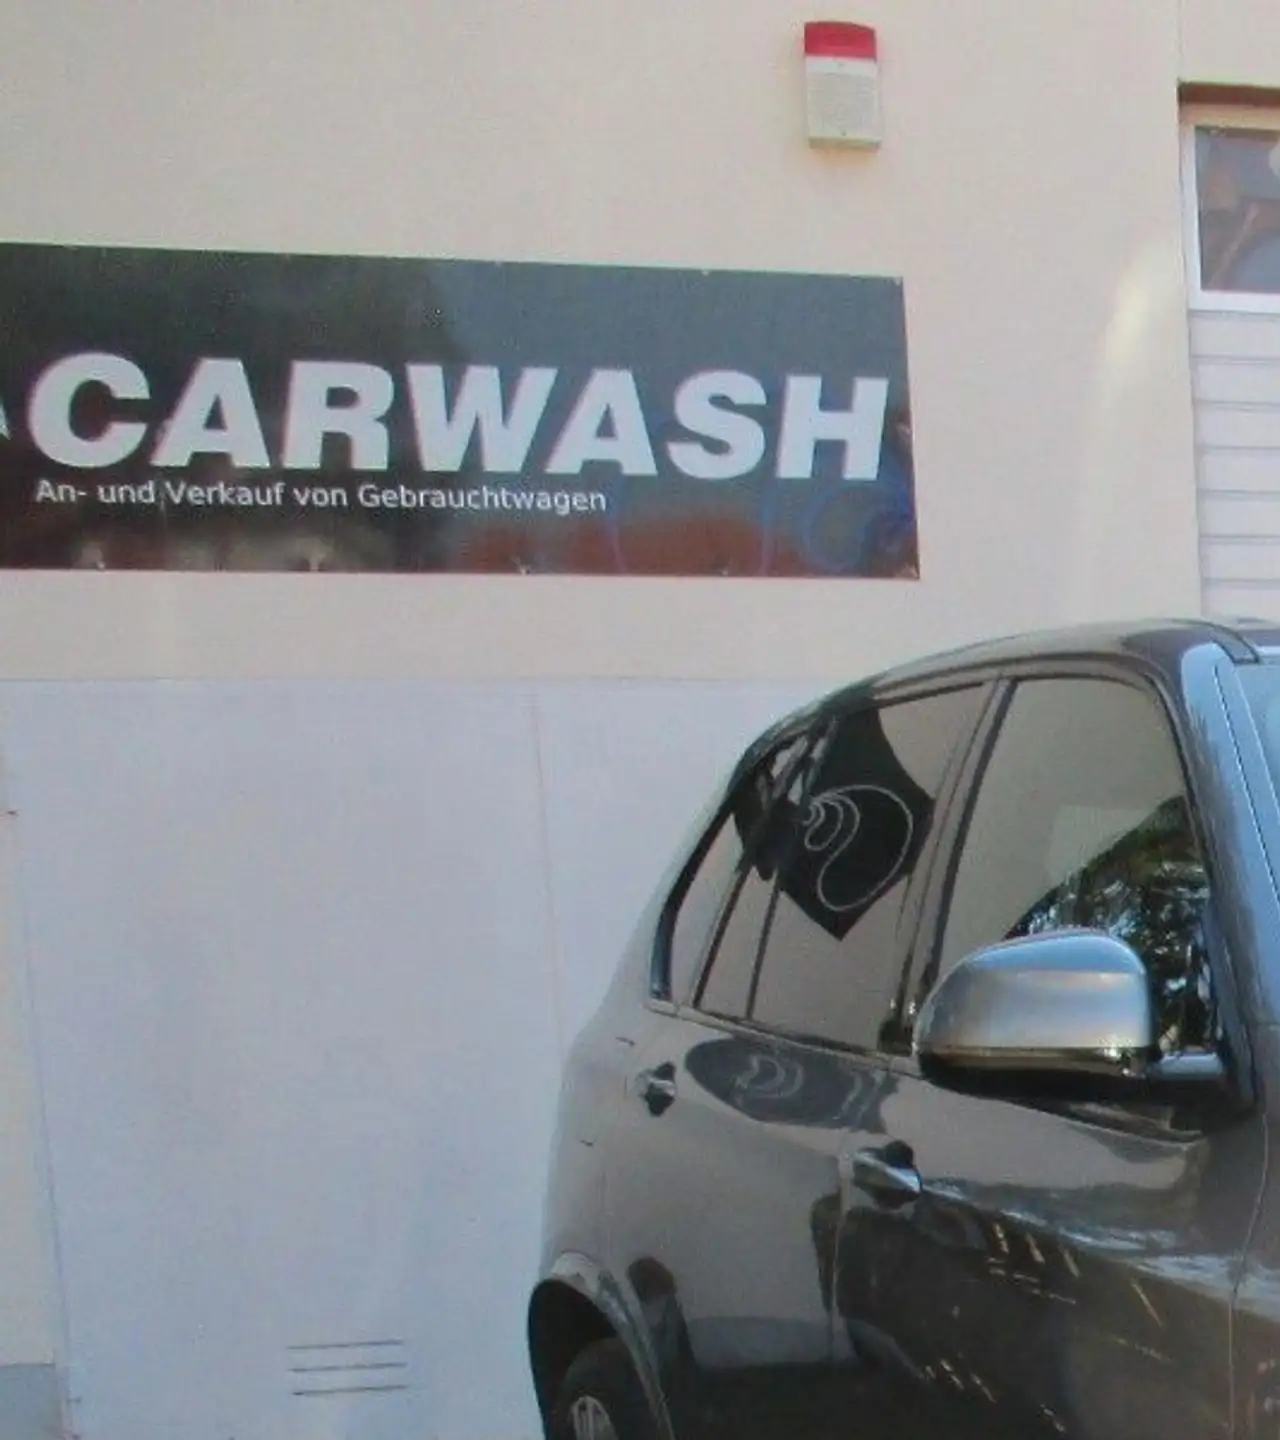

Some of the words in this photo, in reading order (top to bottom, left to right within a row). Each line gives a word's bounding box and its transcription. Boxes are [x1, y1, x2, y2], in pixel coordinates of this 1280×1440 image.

[27, 352, 890, 481] CARWASH
[36, 478, 88, 502] An-
[99, 480, 154, 504] und
[159, 480, 286, 506] Verkauf
[293, 487, 348, 508] von
[357, 484, 607, 515] Gebrauchtwagen
